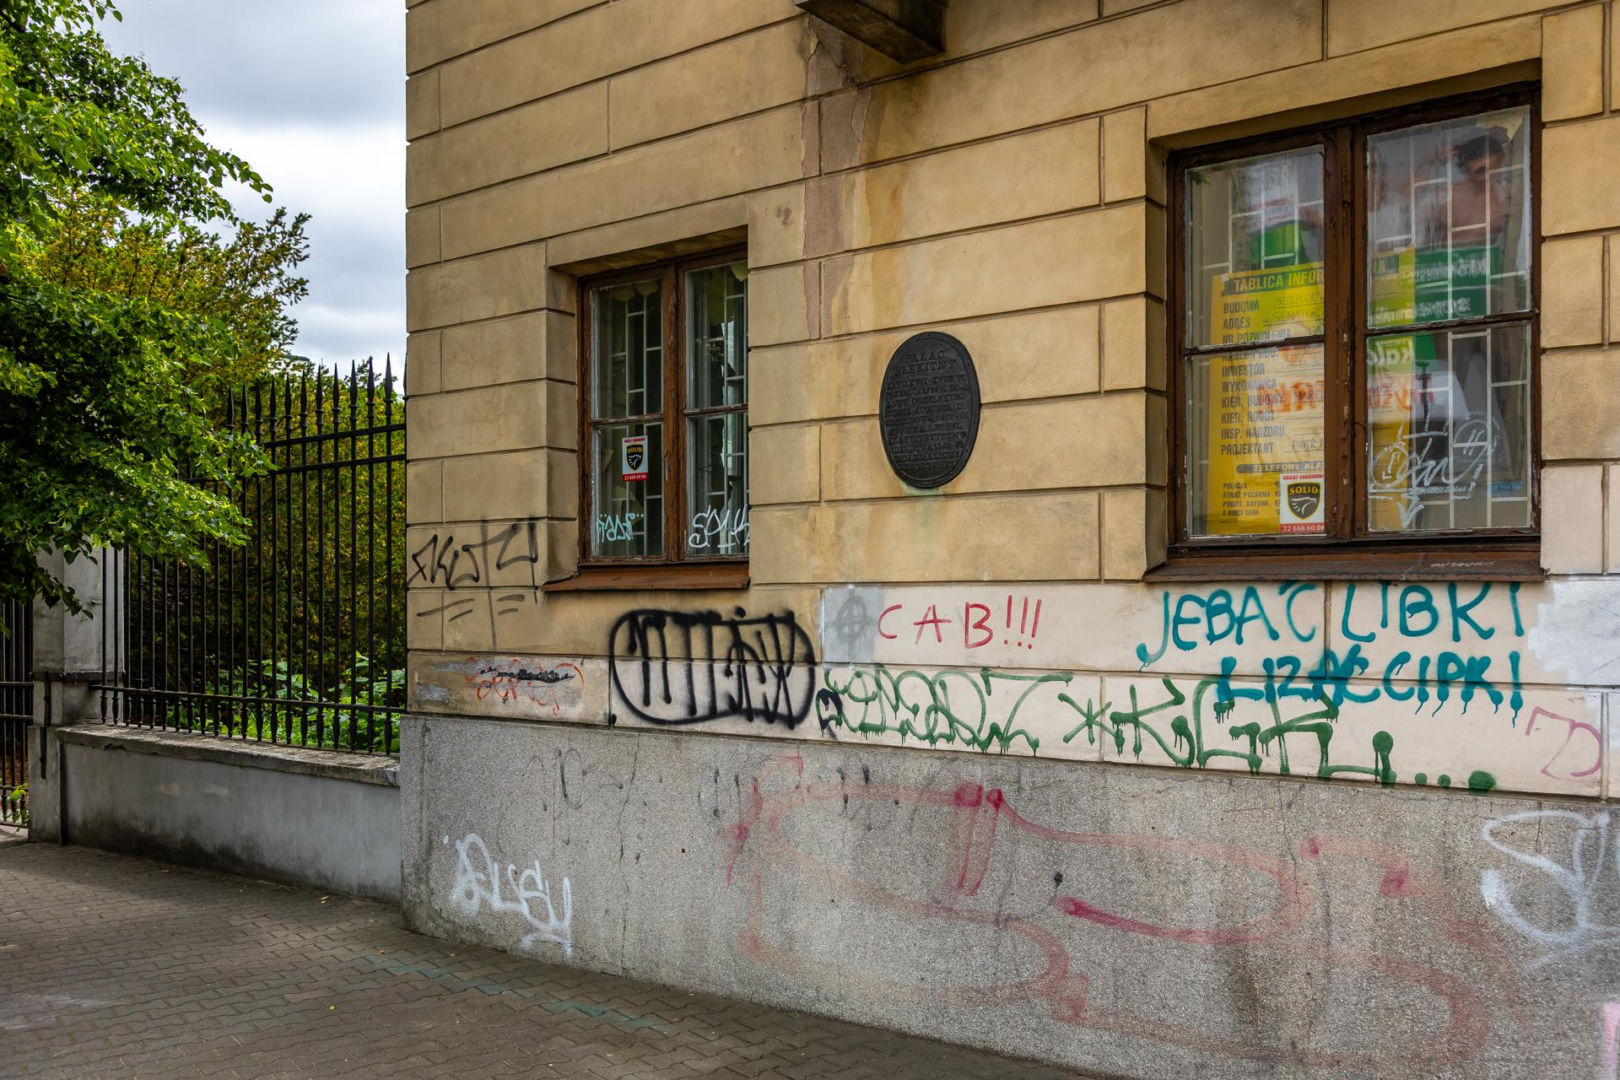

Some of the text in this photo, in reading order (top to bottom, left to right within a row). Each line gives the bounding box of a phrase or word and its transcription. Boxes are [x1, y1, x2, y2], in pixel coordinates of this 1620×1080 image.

[1234, 274, 1284, 292] TABLICA
[1224, 300, 1259, 313] BUDOWA
[1222, 316, 1251, 330] ADRES
[1222, 362, 1266, 377] INWESTOR
[1222, 379, 1276, 393] WYKONAWCA
[1221, 392, 1284, 409] KIER. BUDOWY
[1221, 411, 1244, 424] KIER.
[1221, 425, 1285, 440] INSP. NADZORU
[1221, 442, 1274, 455] PROJEKTANT
[1289, 486, 1319, 496] SOLID
[877, 594, 1043, 650] CAB!!!
[1135, 581, 1318, 671] JEBAĆ
